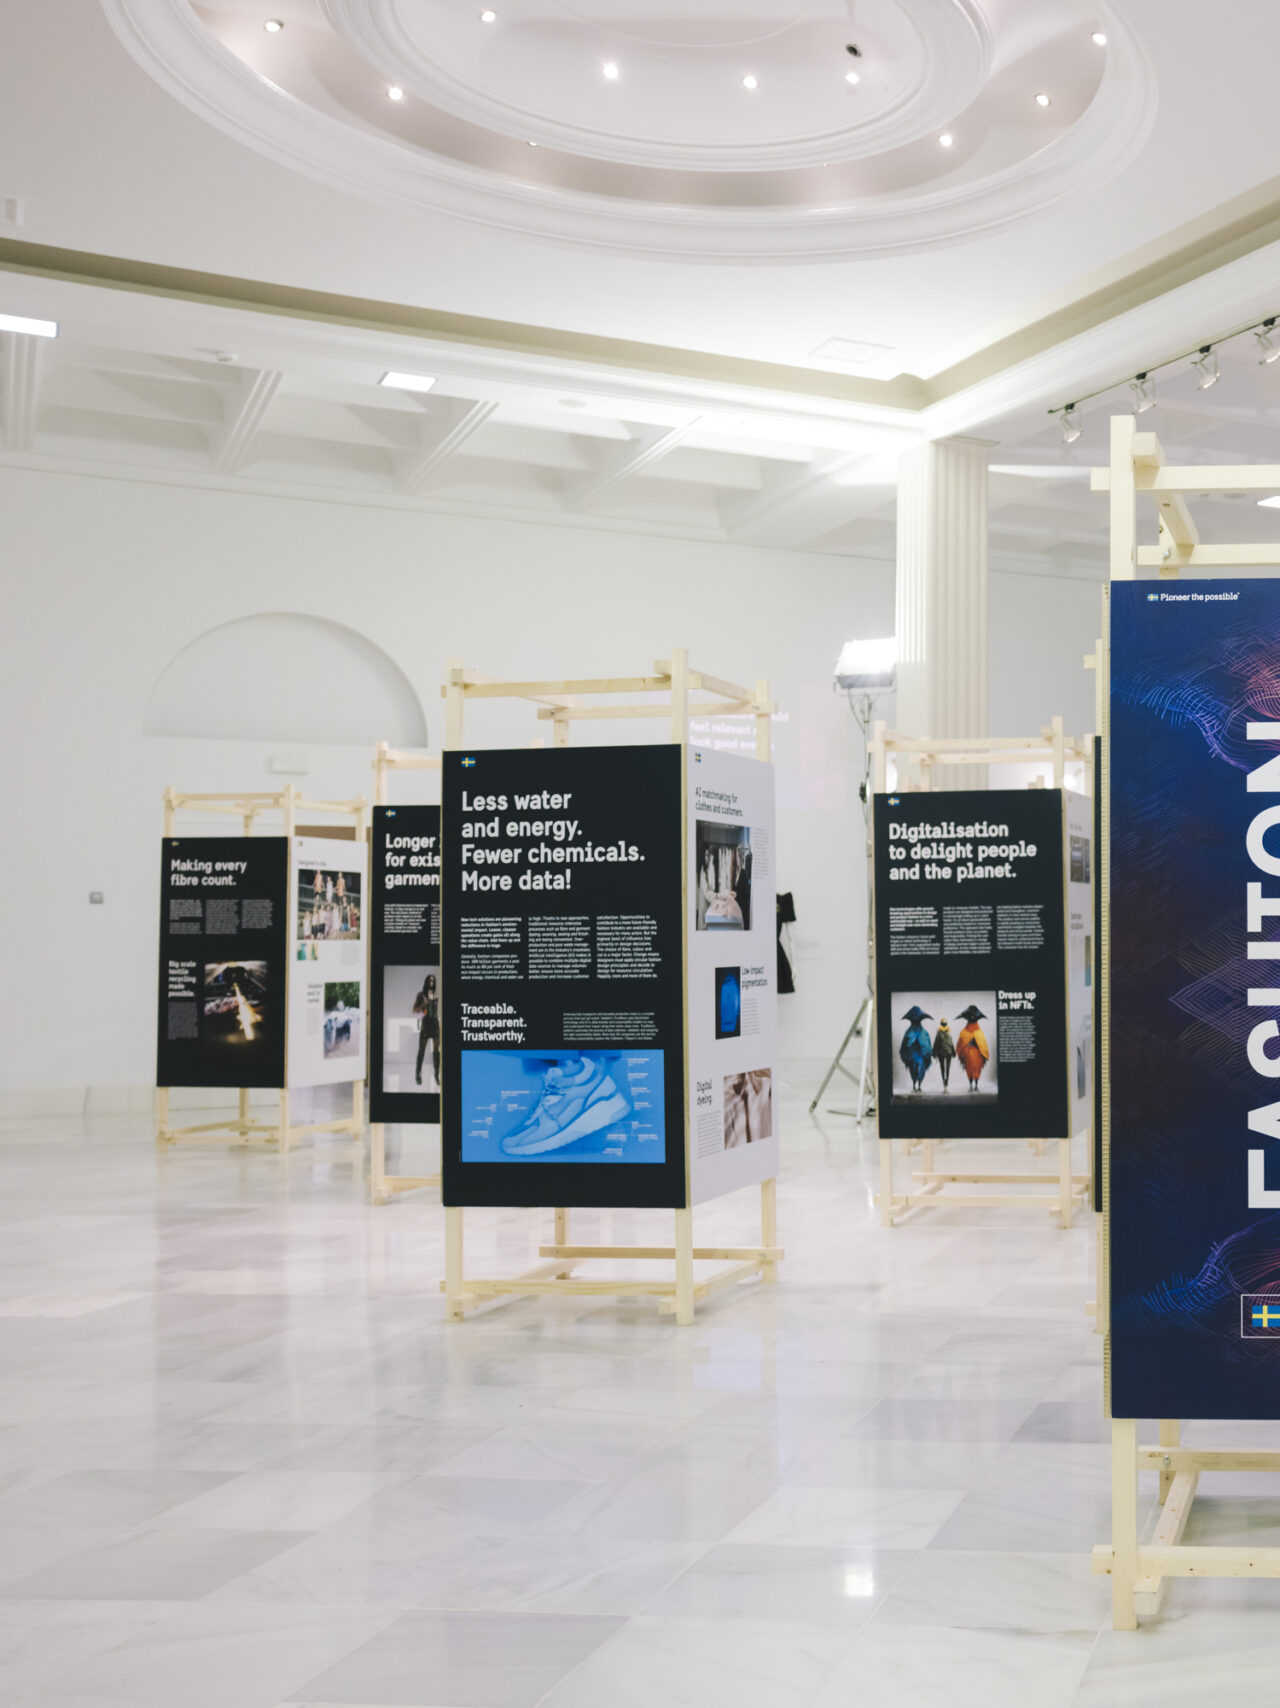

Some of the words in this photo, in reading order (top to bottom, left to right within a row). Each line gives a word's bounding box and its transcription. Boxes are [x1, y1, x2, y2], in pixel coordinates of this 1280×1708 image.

[1161, 593, 1190, 601] Pioneer
[462, 791, 508, 811] Less
[514, 790, 572, 810] water
[462, 817, 499, 838] and
[506, 820, 582, 841] energy.
[889, 821, 1009, 842] Digitalisation
[386, 833, 436, 851] Longer
[462, 844, 522, 864] Fewer
[528, 841, 645, 864] chemicals.
[889, 845, 906, 860] to
[911, 842, 972, 862] delight
[978, 841, 1038, 862] people
[171, 859, 212, 873] Making
[215, 862, 247, 873] every
[385, 852, 406, 867] for
[171, 874, 198, 886] fibre
[201, 875, 236, 886] count.
[462, 871, 512, 891] More
[519, 869, 571, 890] data!
[889, 863, 920, 880] and
[924, 862, 953, 879] the
[957, 862, 1016, 883] planet.
[998, 990, 1022, 1001] Dress
[1024, 992, 1036, 1001] up
[461, 1003, 516, 1014] Traceable.
[999, 1001, 1008, 1010] in
[1010, 1001, 1034, 1010] NFTs.
[461, 1017, 527, 1030] Transparent.
[461, 1030, 525, 1043] Trustworthy.
